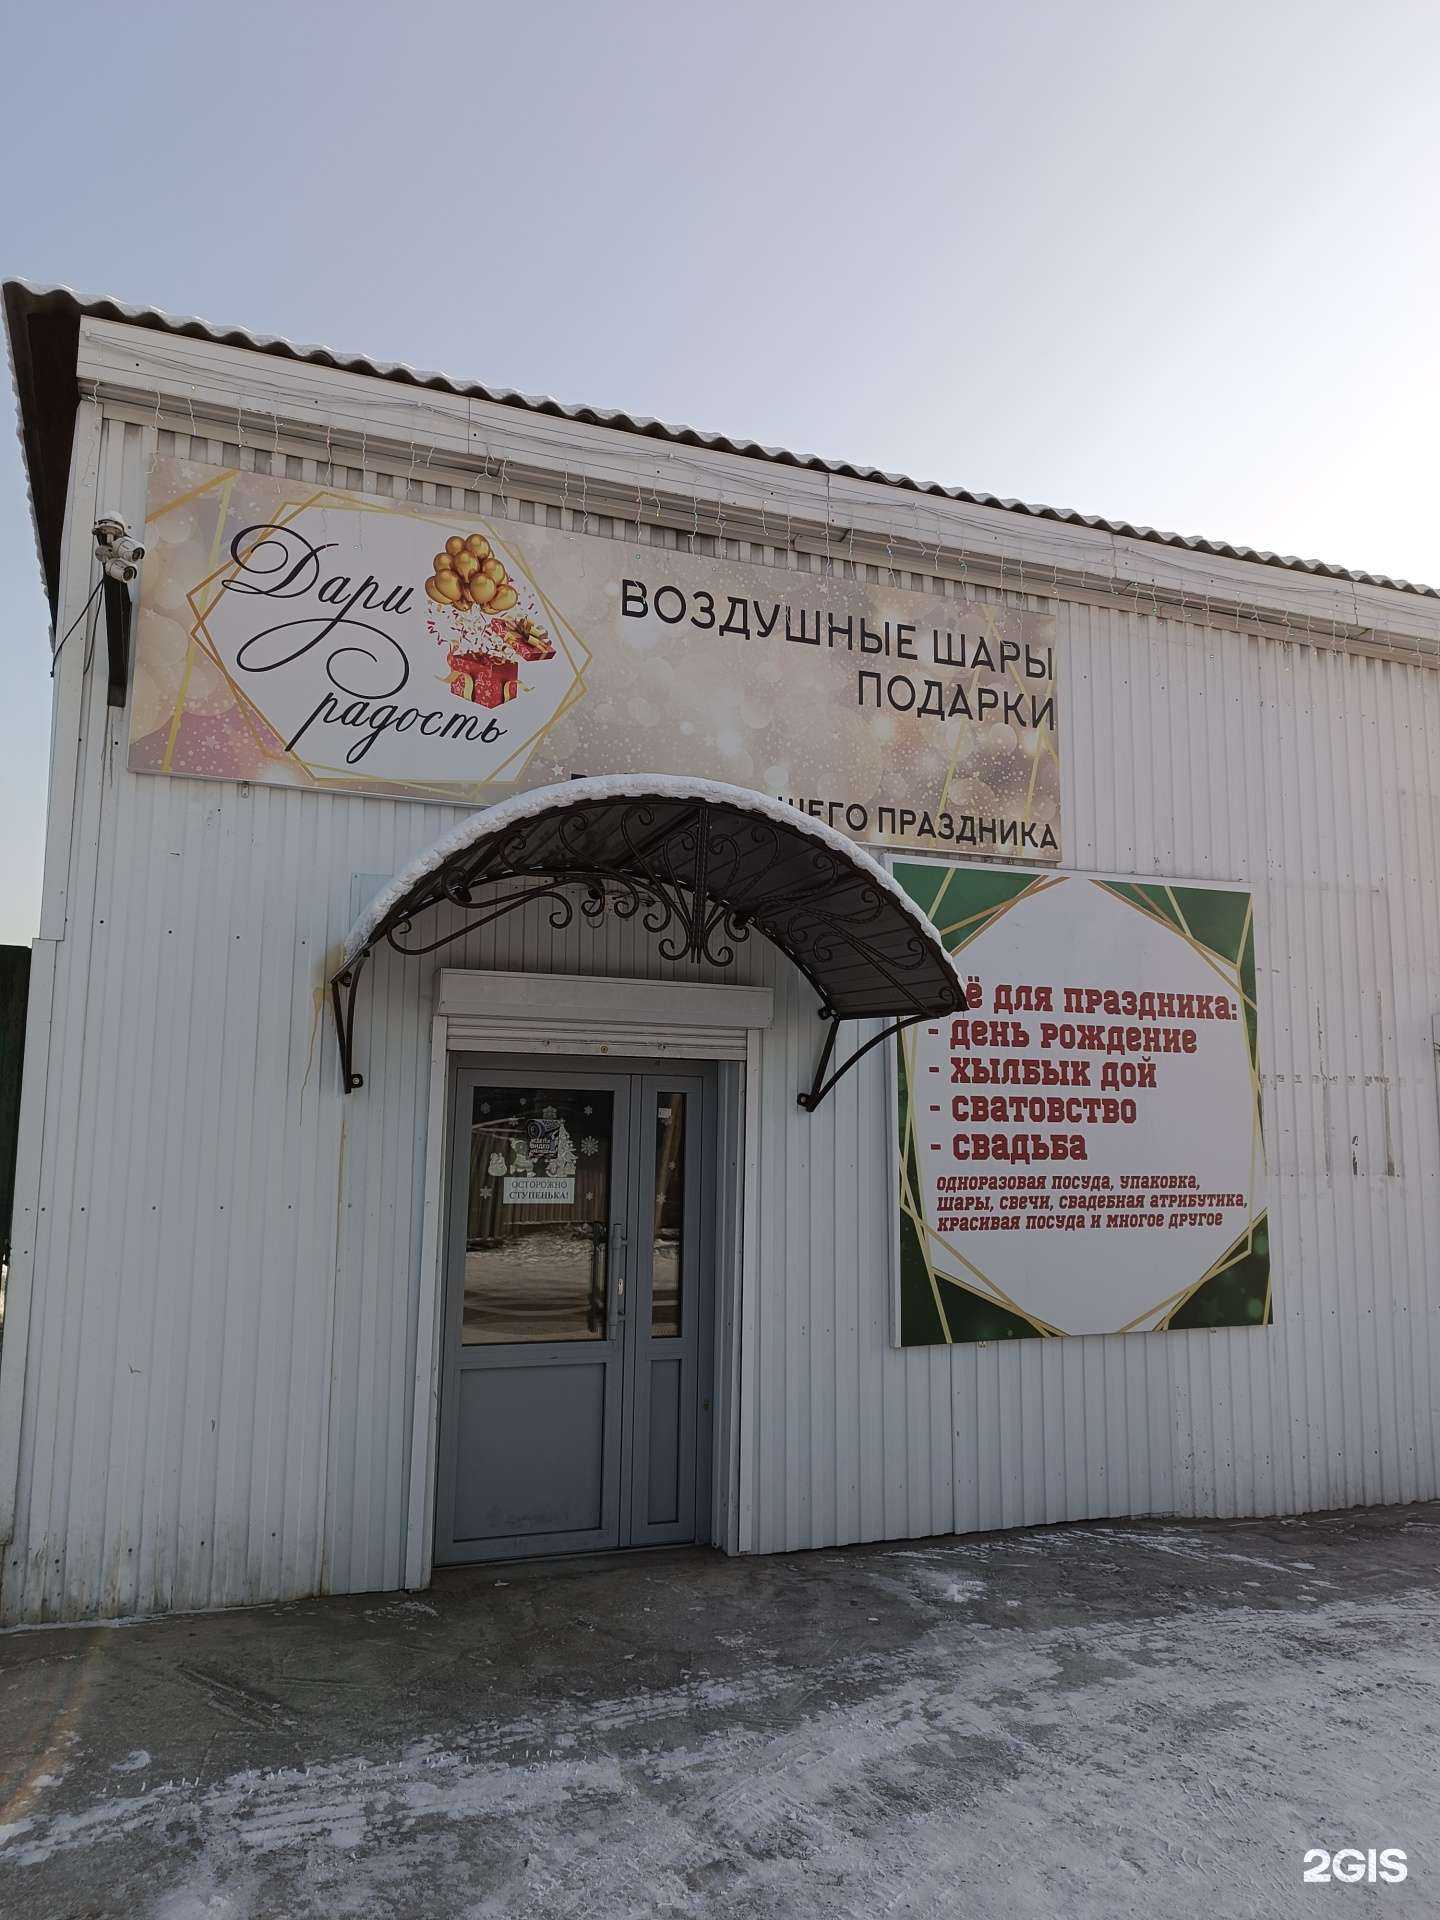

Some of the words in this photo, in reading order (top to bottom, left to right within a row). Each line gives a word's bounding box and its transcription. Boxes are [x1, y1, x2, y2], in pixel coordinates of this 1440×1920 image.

[221, 525, 413, 699] Дари
[621, 579, 918, 661] ВОЗДУШНЫЕ
[933, 628, 1054, 681] ШАРЫ
[285, 691, 507, 764] радость
[858, 670, 1055, 731] ПОДАРКИ
[878, 806, 1059, 850] ПРАЗДНИКА
[509, 1191, 569, 1200] СТУПЕНЬКА!
[511, 1181, 568, 1189] ОСТОРОЖНО
